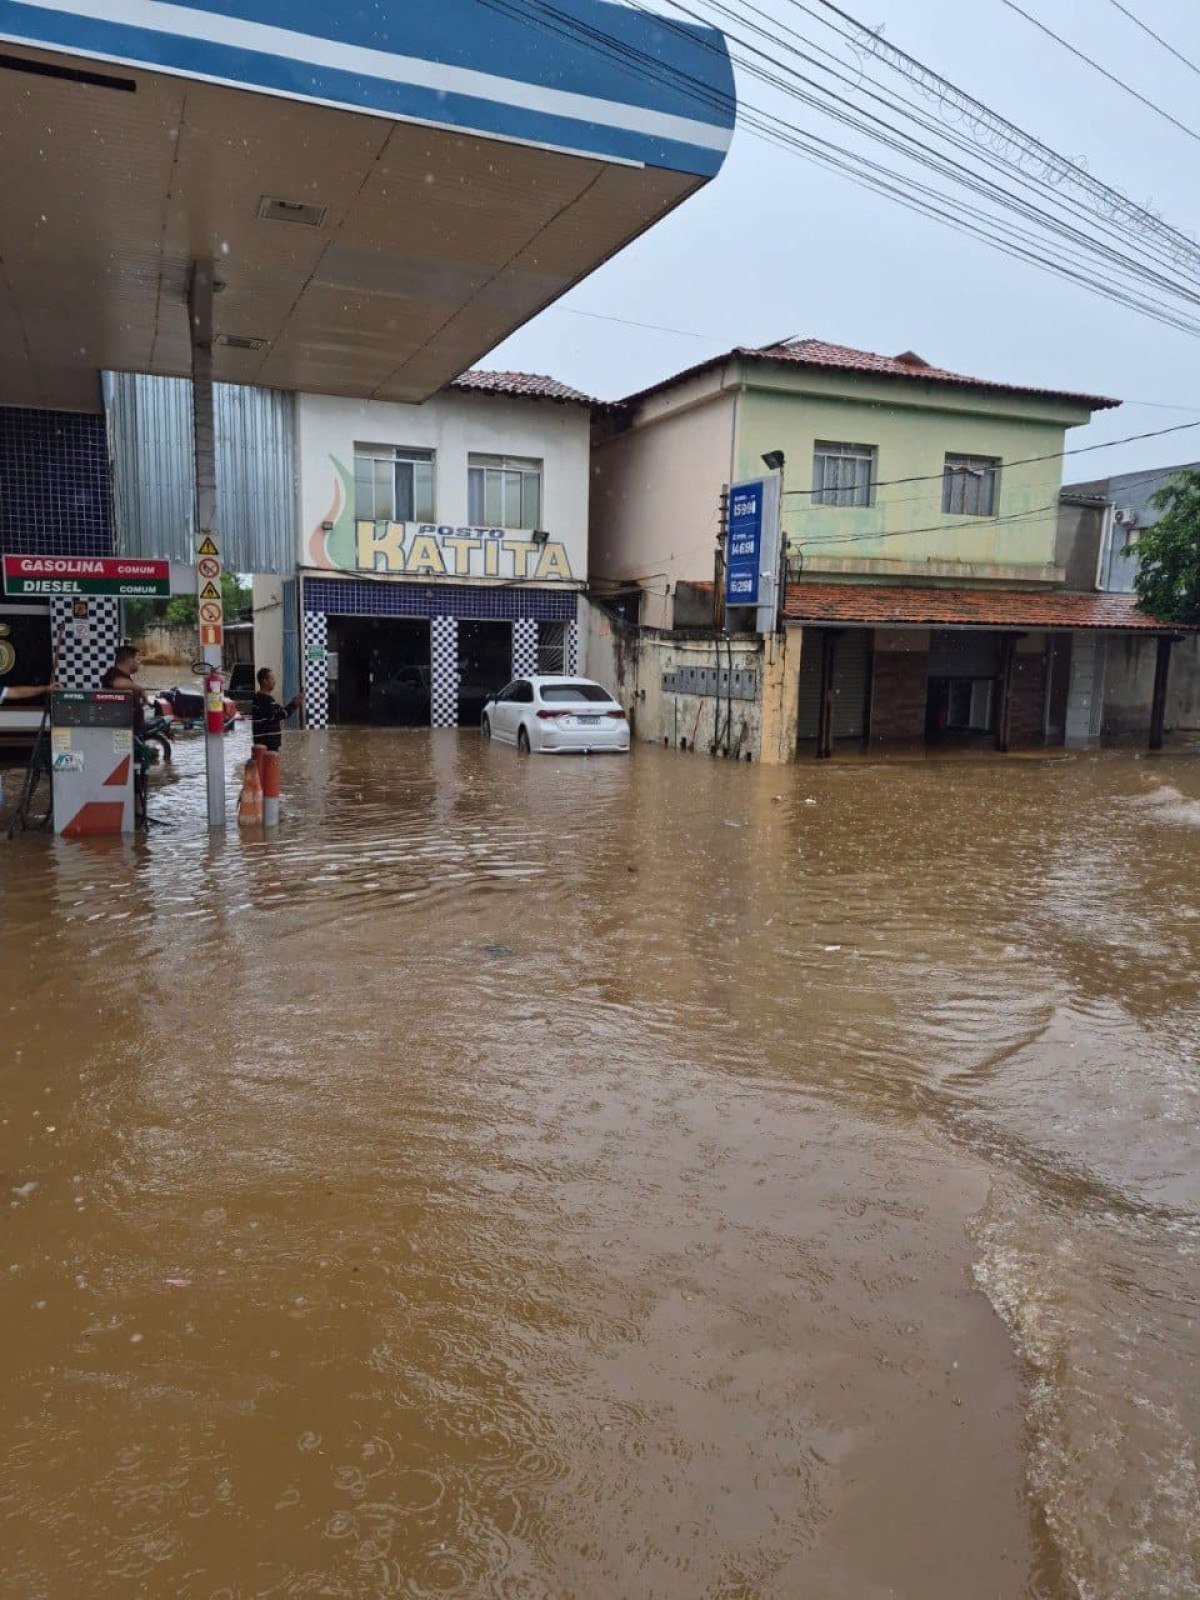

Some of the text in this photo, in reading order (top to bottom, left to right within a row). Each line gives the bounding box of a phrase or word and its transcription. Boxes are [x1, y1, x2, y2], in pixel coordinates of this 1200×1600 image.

[418, 525, 505, 539] POSTO
[355, 519, 573, 580] KATITA
[20, 559, 156, 575] GASOLINA COMUM
[23, 580, 157, 594] DIESEL COMUM
